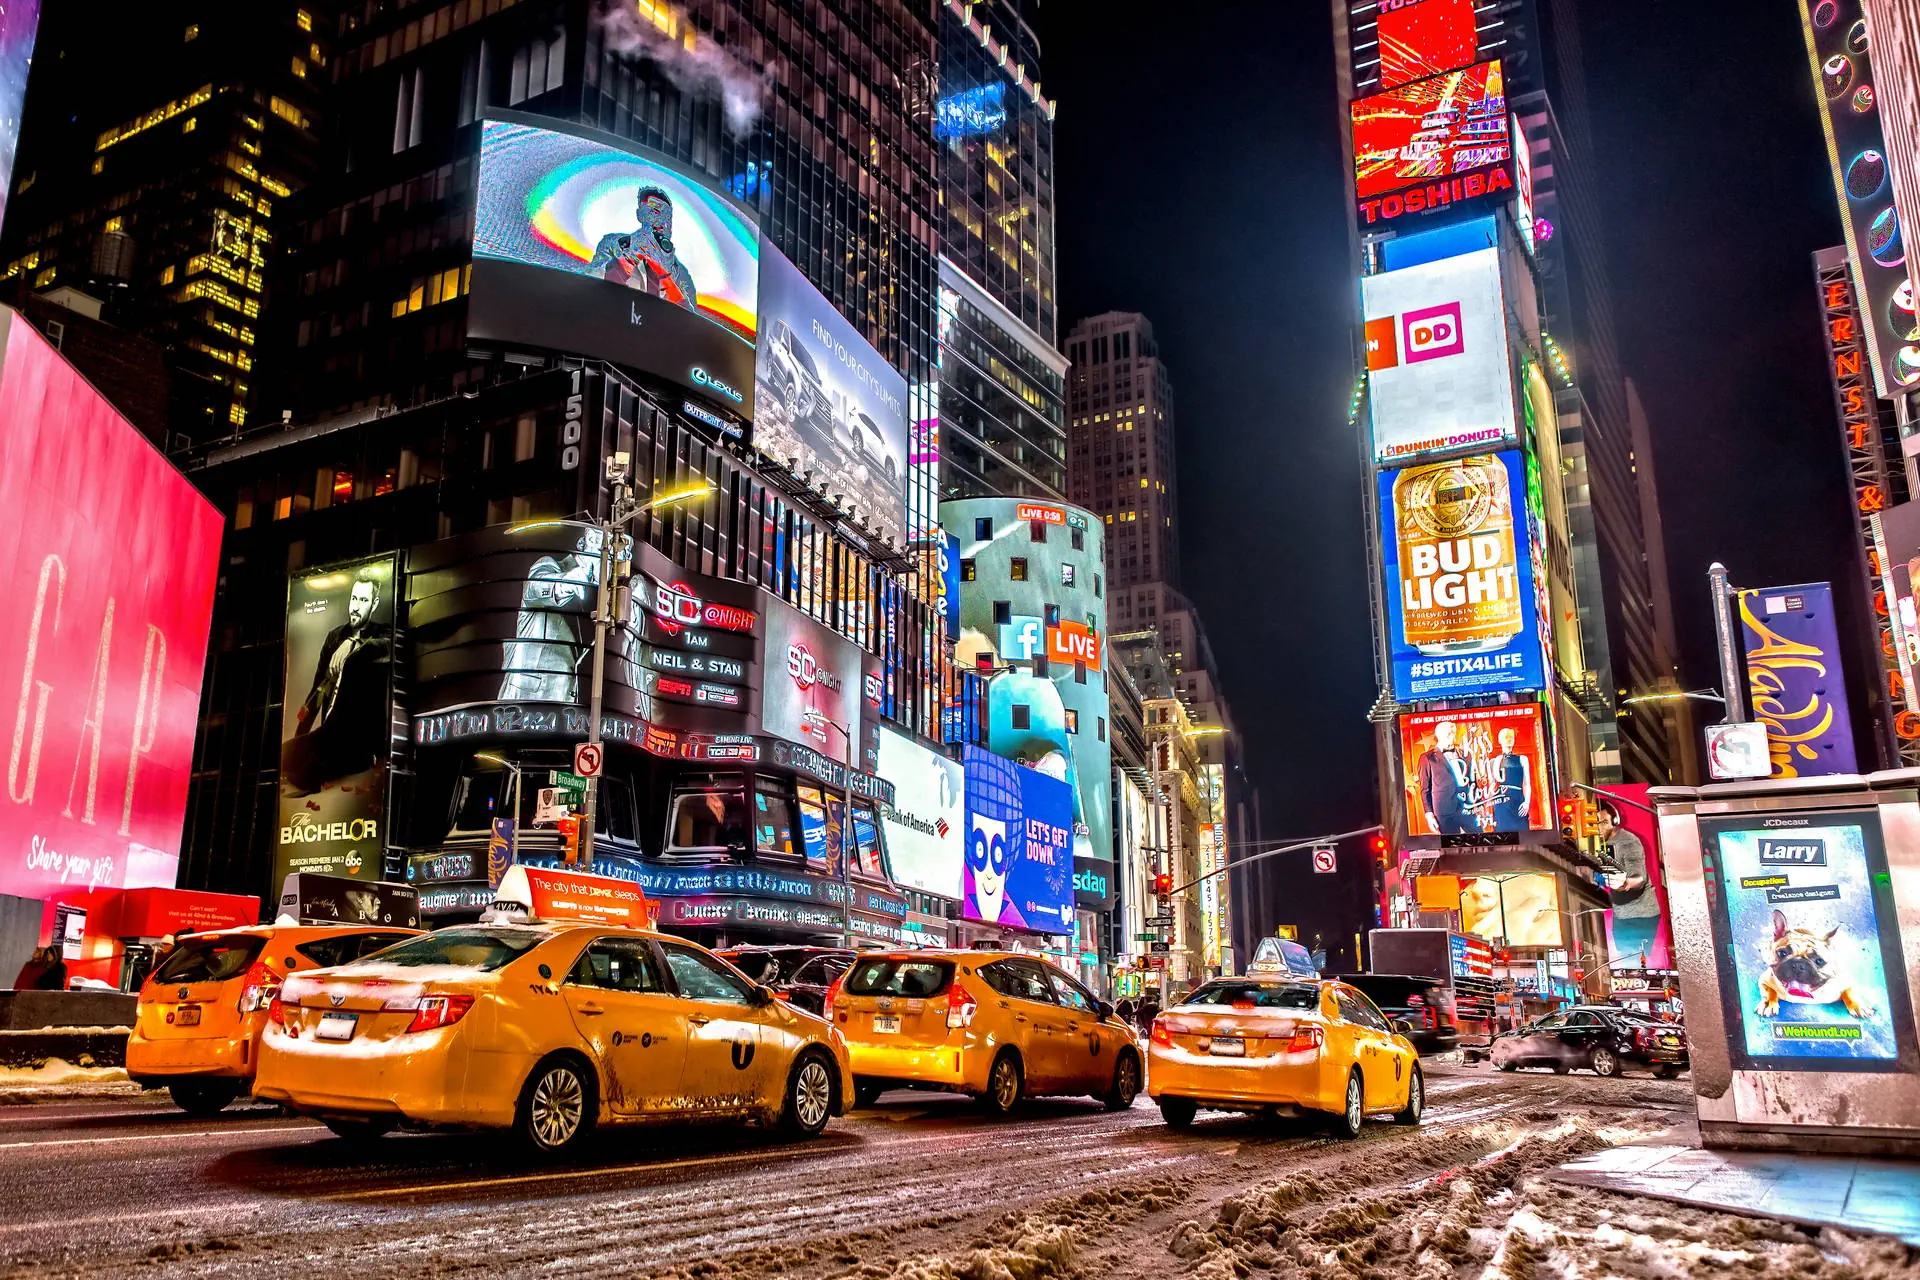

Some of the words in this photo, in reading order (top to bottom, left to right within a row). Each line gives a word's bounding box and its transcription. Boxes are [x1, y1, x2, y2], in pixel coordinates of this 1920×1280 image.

[1359, 167, 1513, 224] TOSHIBA
[1414, 322, 1452, 346] DD
[812, 318, 833, 349] FIND
[833, 338, 857, 375] YOUR
[857, 363, 880, 396] CITY'S
[879, 383, 902, 418] LIMITS
[1826, 282, 1869, 450] ERNST
[707, 375, 743, 403] LEXUS
[561, 370, 583, 470] 1500
[1395, 437, 1448, 455] DUNKIN'
[1449, 427, 1501, 445] DONUTS
[1021, 507, 1042, 518] LIVE
[1411, 534, 1501, 578] BUD
[1404, 565, 1515, 611] LIGHT
[656, 586, 703, 624] SC
[1056, 631, 1096, 660] LIVE
[652, 651, 687, 669] NEIL
[691, 657, 704, 671] &
[708, 660, 741, 677] STAN
[787, 645, 816, 684] SC
[1410, 652, 1523, 678] #SBTIX4LIFE
[8, 553, 167, 837] GAP
[657, 678, 692, 697] ESPN
[557, 774, 586, 790] Broadway
[280, 818, 377, 845] BACHELOR
[290, 812, 312, 828] The
[903, 811, 911, 828] of
[910, 813, 935, 837] America
[1025, 818, 1050, 843] LET'S
[1051, 826, 1069, 849] GET
[1763, 818, 1809, 827] JCDecaux
[27, 833, 63, 872] Share
[61, 852, 91, 884] your
[88, 856, 113, 895] gift
[289, 858, 309, 867] SEASON
[345, 856, 363, 867] abc
[1025, 840, 1056, 866] DOWN.
[1762, 841, 1819, 863] Larry
[532, 877, 552, 891] The
[552, 880, 570, 895] city
[570, 882, 589, 896] that
[1775, 1025, 1861, 1039] #WeHoundLove
